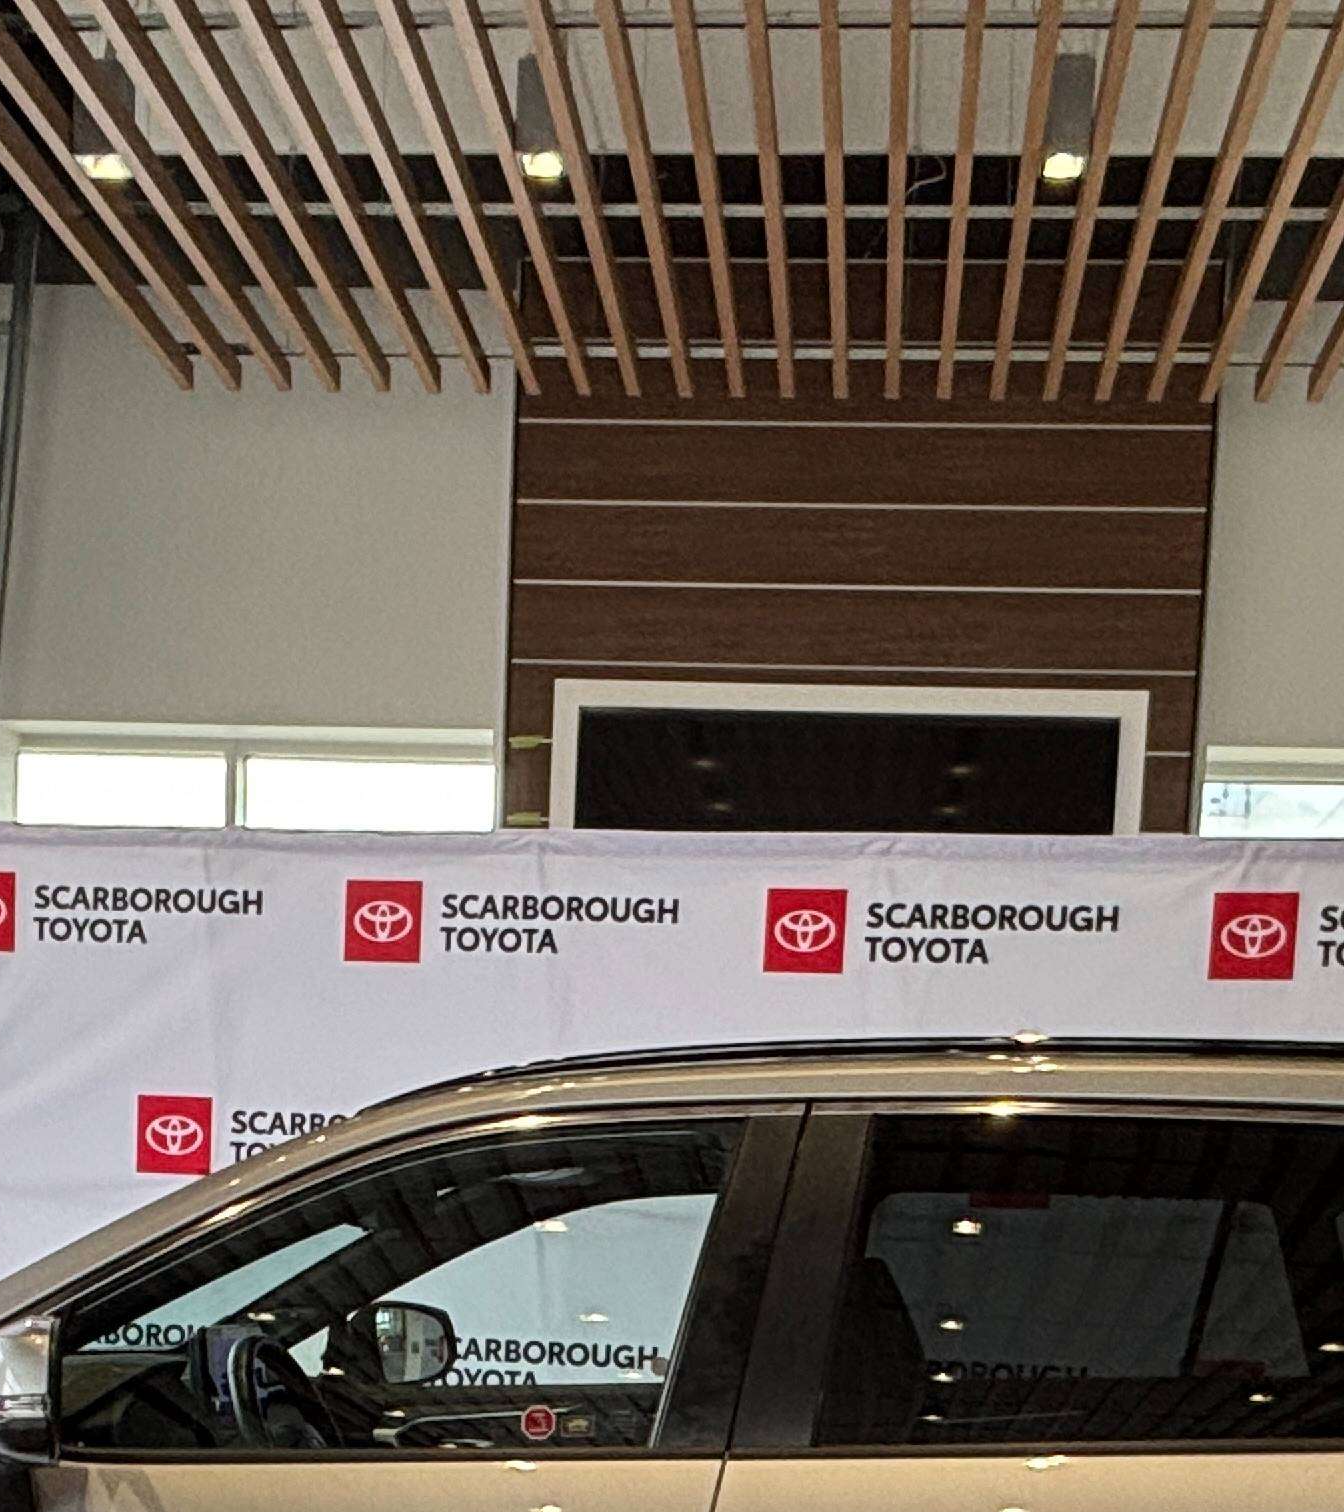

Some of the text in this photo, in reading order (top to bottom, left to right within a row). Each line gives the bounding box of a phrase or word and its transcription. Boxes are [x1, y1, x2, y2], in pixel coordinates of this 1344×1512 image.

[33, 885, 264, 916] SCARBOROUGH
[441, 894, 680, 924] SCARBOROUGH
[32, 916, 148, 944] TOYOTA
[865, 902, 1120, 932] SCARBOROUGH
[440, 926, 559, 954] TOYOTA
[864, 936, 989, 964] TOYOTA
